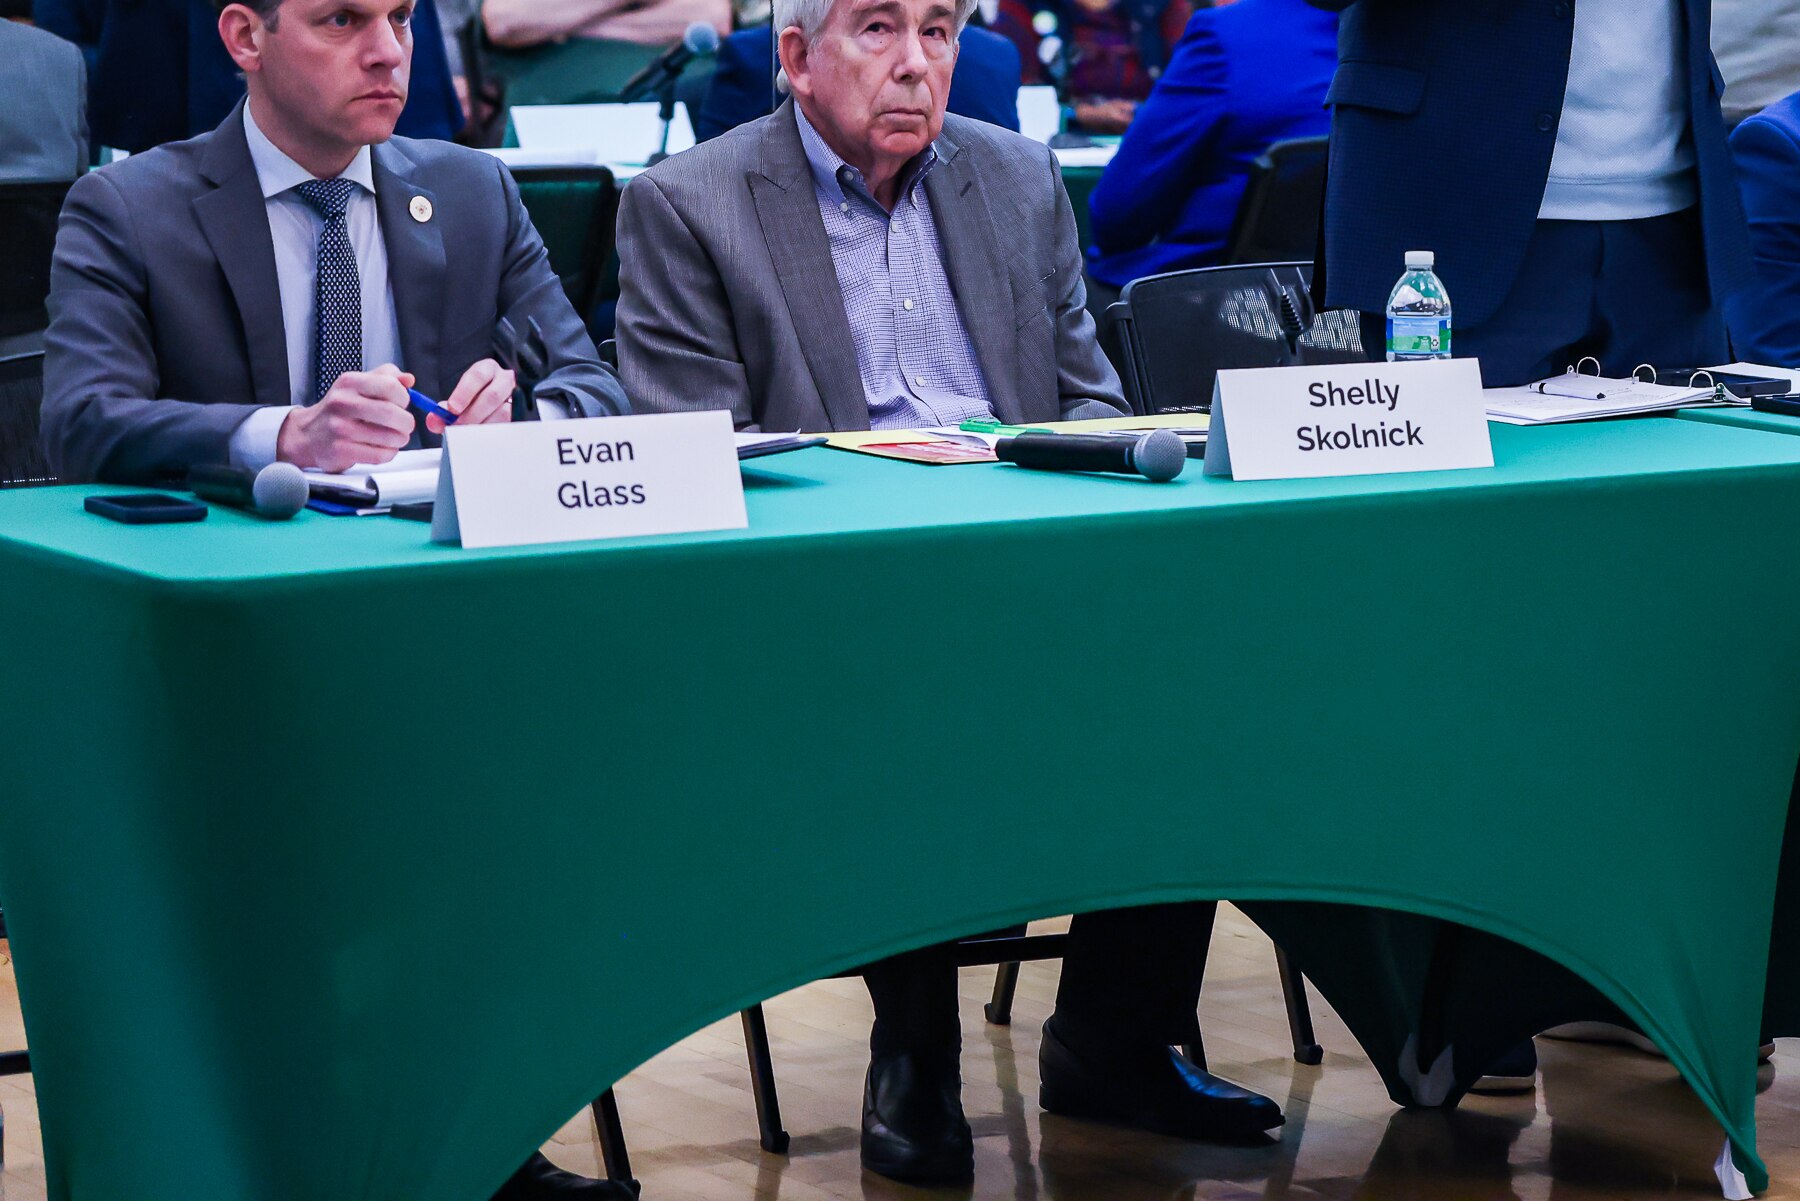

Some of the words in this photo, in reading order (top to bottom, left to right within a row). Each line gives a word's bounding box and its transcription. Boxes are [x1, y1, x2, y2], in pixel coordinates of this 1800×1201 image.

[1308, 377, 1400, 412] Shelly
[1297, 419, 1424, 452] Skolnick
[557, 437, 635, 466] Evan
[556, 480, 647, 510] Glass
